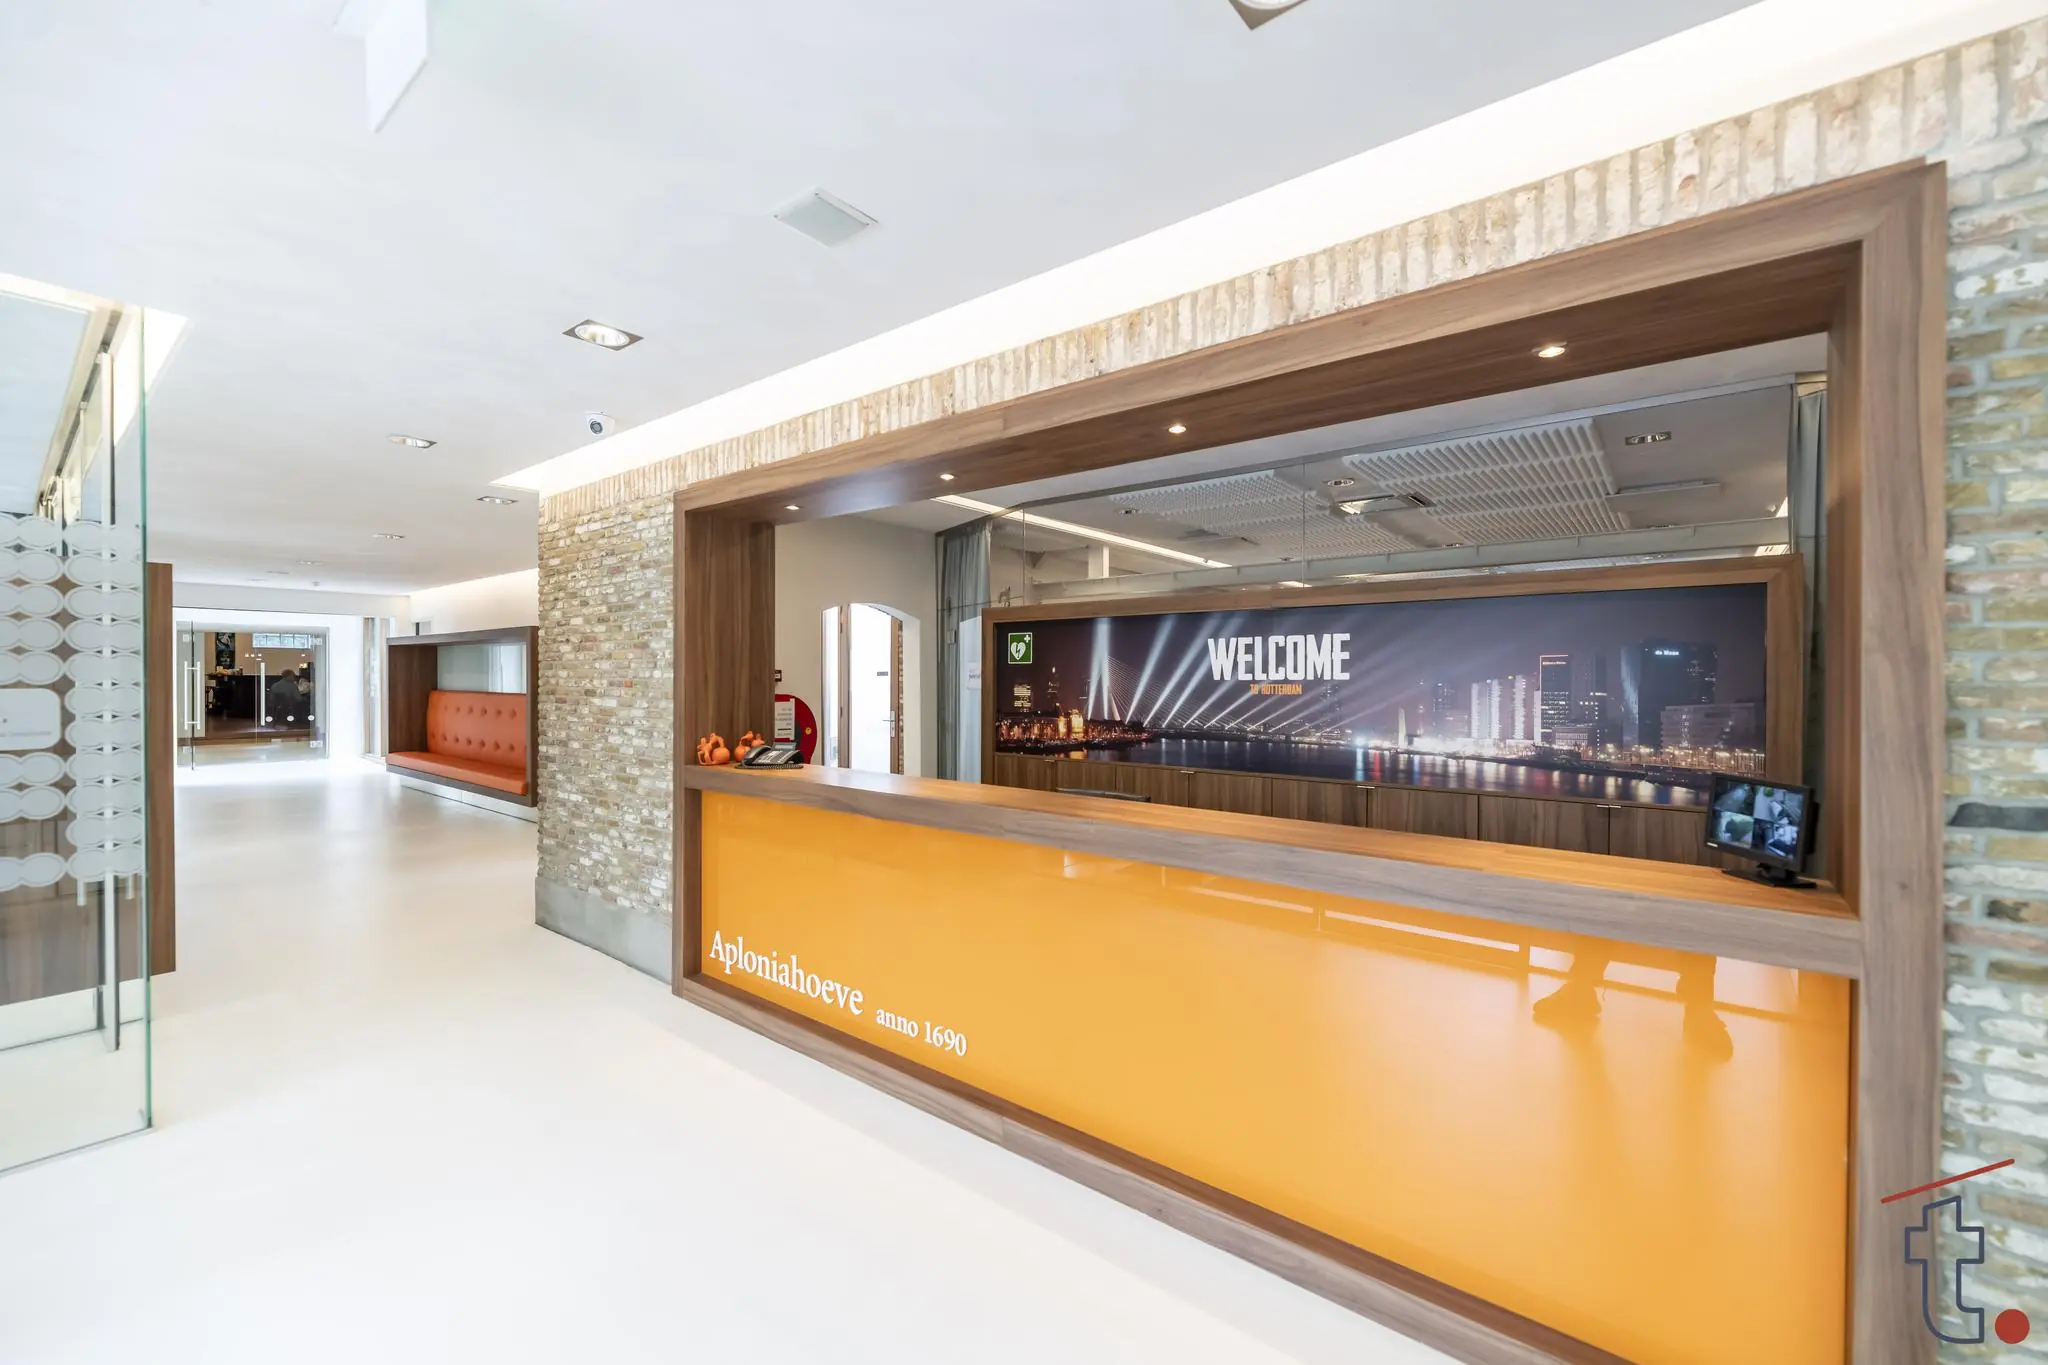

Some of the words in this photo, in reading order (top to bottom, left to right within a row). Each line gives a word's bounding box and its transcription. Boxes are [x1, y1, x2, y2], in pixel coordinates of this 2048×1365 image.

[1208, 633, 1350, 681] WELCOME
[1250, 684, 1259, 695] TO
[1261, 684, 1303, 695] ROTTERDAM
[709, 930, 864, 1015] Aploniahoeve
[876, 1008, 919, 1038] anno
[924, 1021, 967, 1056] 1690
